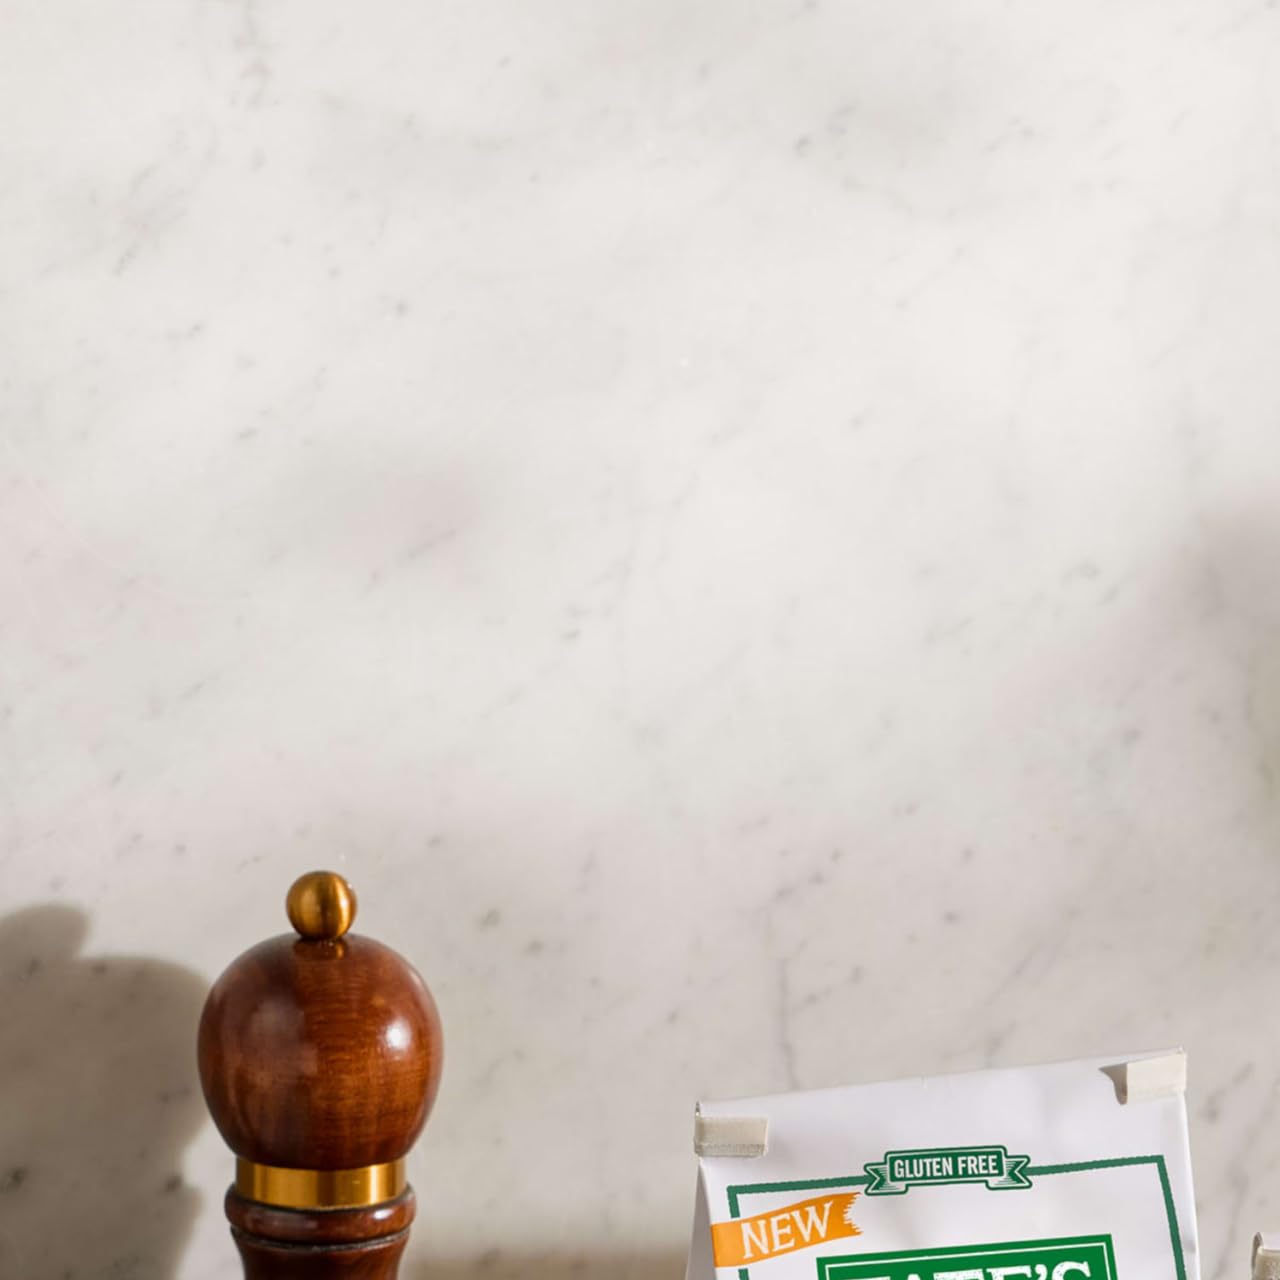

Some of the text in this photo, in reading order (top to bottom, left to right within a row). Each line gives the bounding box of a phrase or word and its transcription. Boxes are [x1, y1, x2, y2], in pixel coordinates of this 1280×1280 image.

[893, 1153, 999, 1180] GLUTEN FREE
[740, 1201, 834, 1260] NEW
